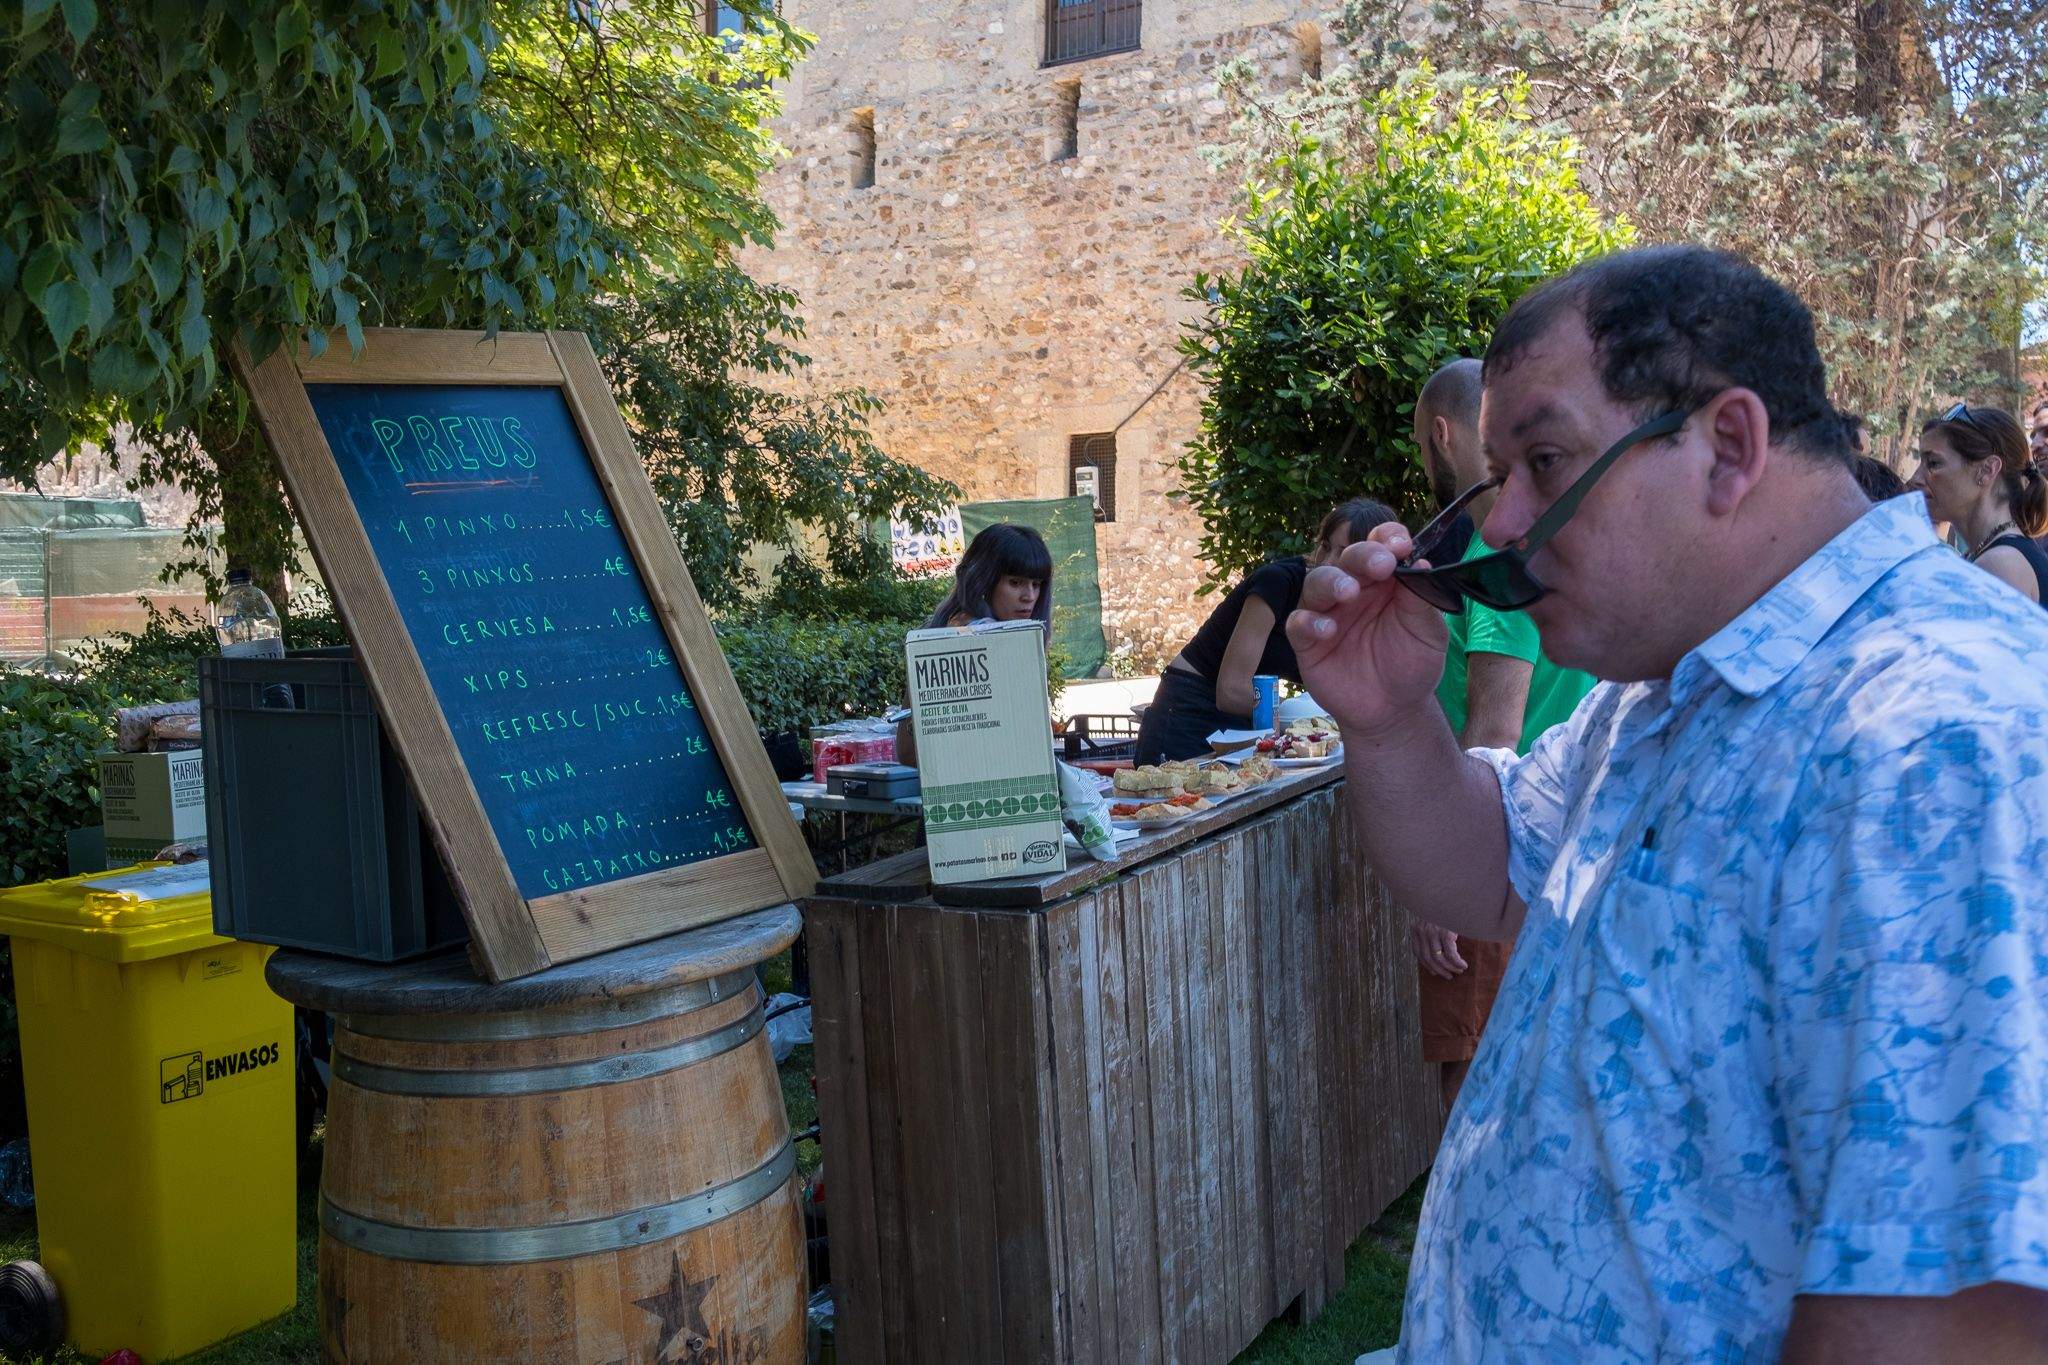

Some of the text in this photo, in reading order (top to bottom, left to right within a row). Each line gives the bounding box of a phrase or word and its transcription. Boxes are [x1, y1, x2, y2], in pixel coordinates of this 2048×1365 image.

[372, 415, 537, 473] PREUS
[398, 519, 413, 544] 1
[424, 512, 517, 540] PINXO
[418, 556, 630, 594] 3 PINXOS 4€
[443, 605, 652, 646] CERVESA 1,5€
[463, 648, 672, 694] XIPS 2€
[915, 653, 989, 689] MARINAS
[918, 683, 992, 702] MEDITERRANEAN CRISPS
[921, 704, 968, 717] ACEITE DE OLIVA
[500, 735, 709, 793] TRINA 2€
[526, 789, 731, 849] POMADA 4€
[1027, 849, 1054, 859] VIDAL
[1029, 843, 1052, 851] Vicente
[543, 850, 661, 890] GAZPATXO
[206, 1042, 279, 1081] ENVASOS
